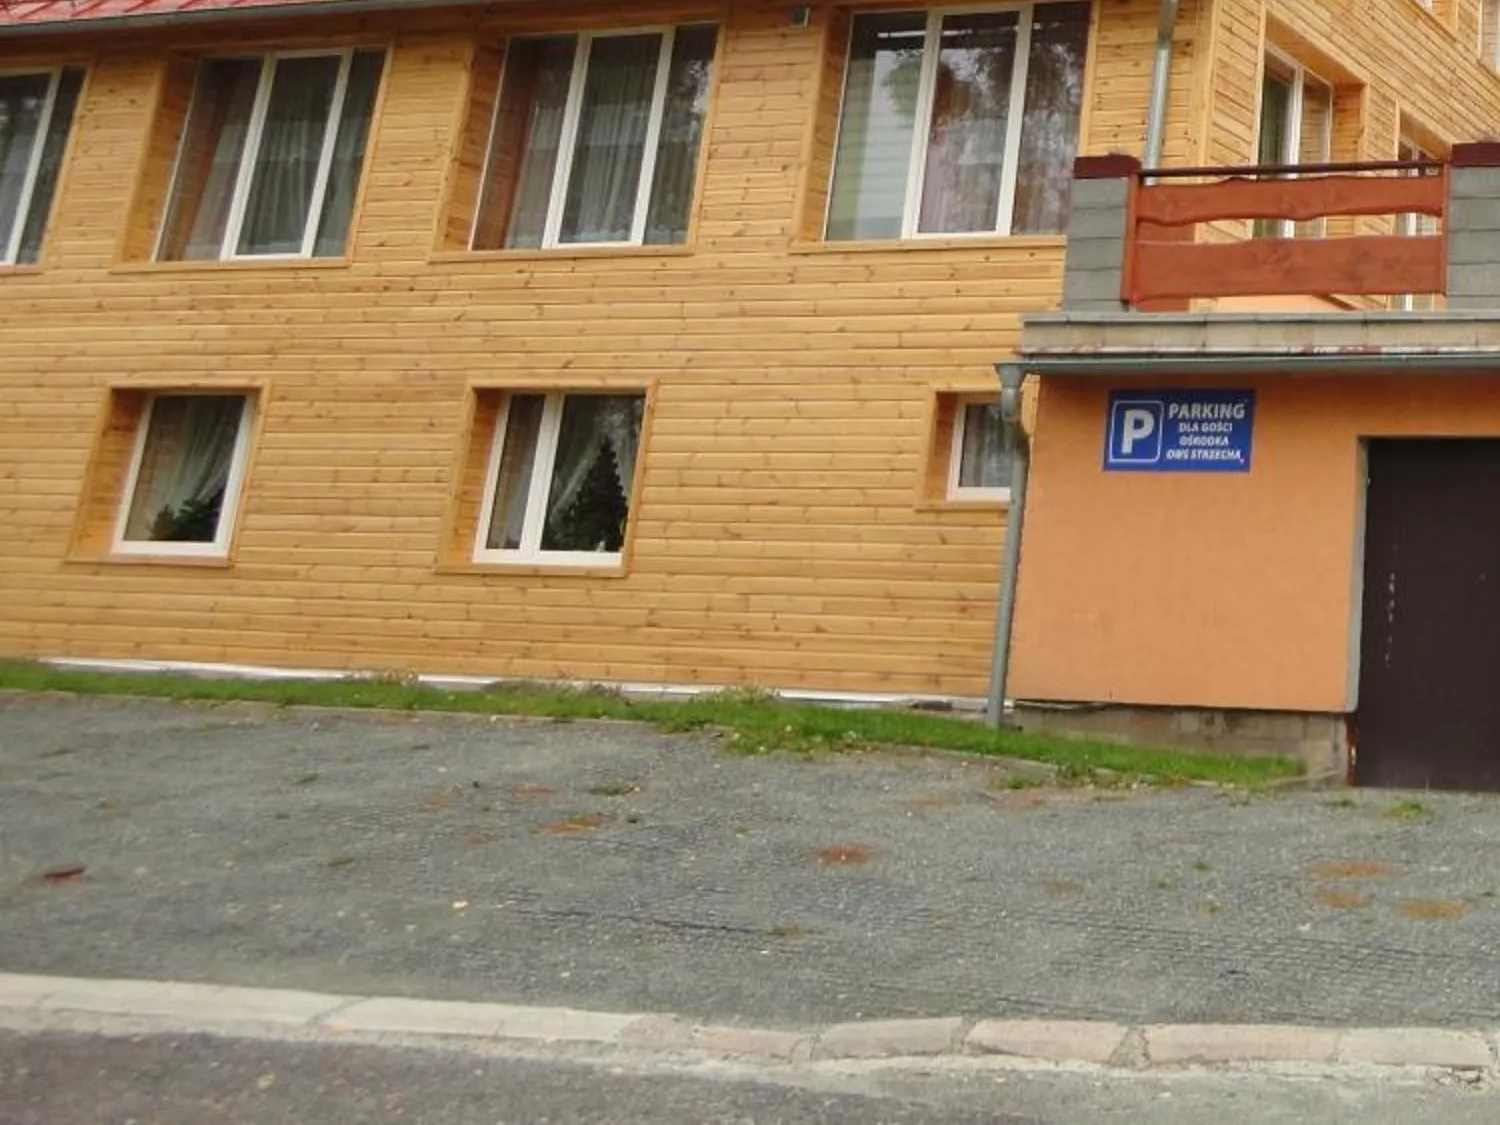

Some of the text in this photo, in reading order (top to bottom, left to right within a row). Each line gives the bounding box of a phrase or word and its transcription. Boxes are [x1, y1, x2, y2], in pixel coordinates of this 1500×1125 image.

[1168, 401, 1246, 420] PARKING
[1121, 408, 1155, 454] P
[1179, 420, 1233, 433] DLA GOŚCI
[1190, 448, 1242, 460] STRZECHA
